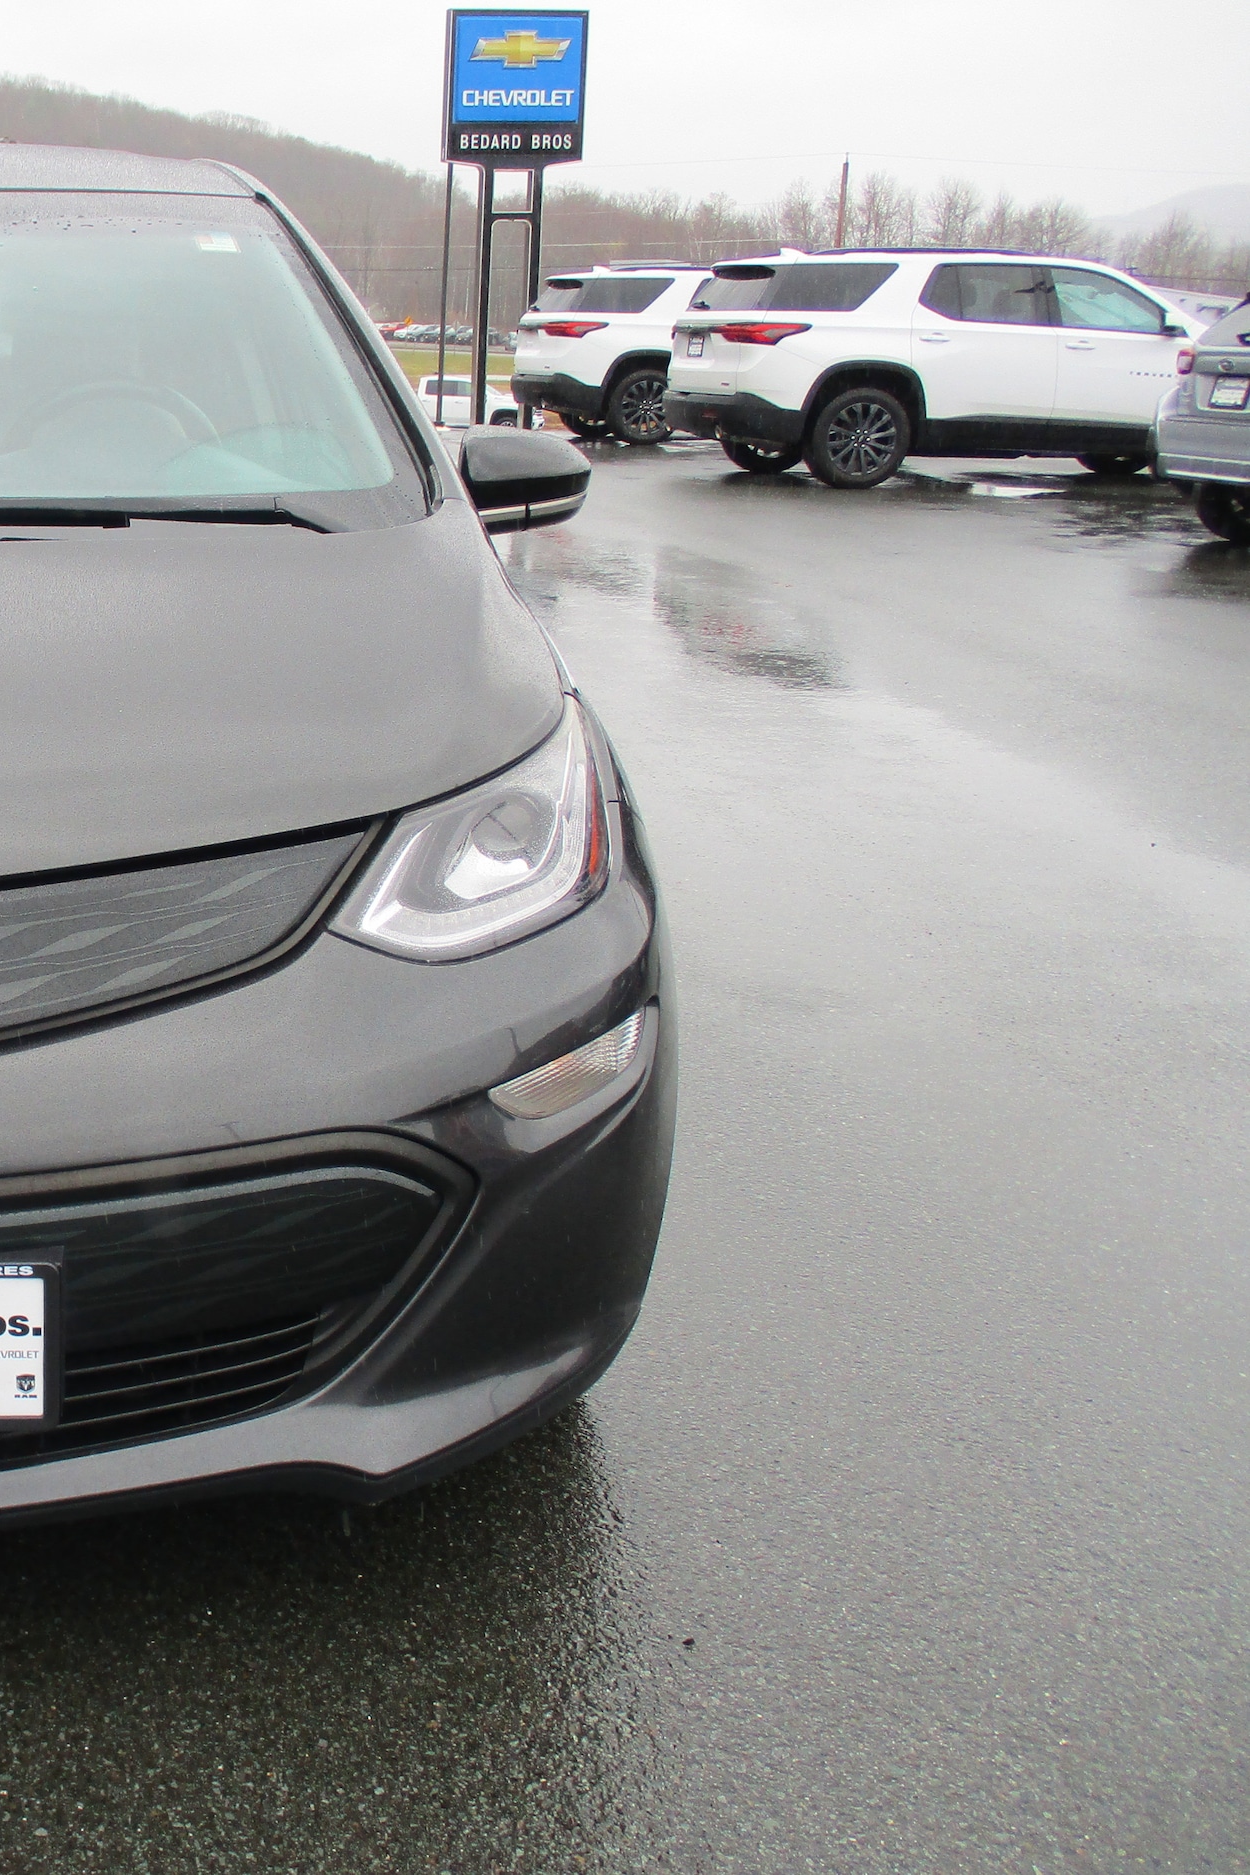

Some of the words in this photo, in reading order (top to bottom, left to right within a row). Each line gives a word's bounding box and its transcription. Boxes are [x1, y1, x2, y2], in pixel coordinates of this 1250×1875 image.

[462, 89, 574, 107] CHEVROLET
[460, 134, 521, 149] BEDARD
[531, 134, 572, 149] BROS
